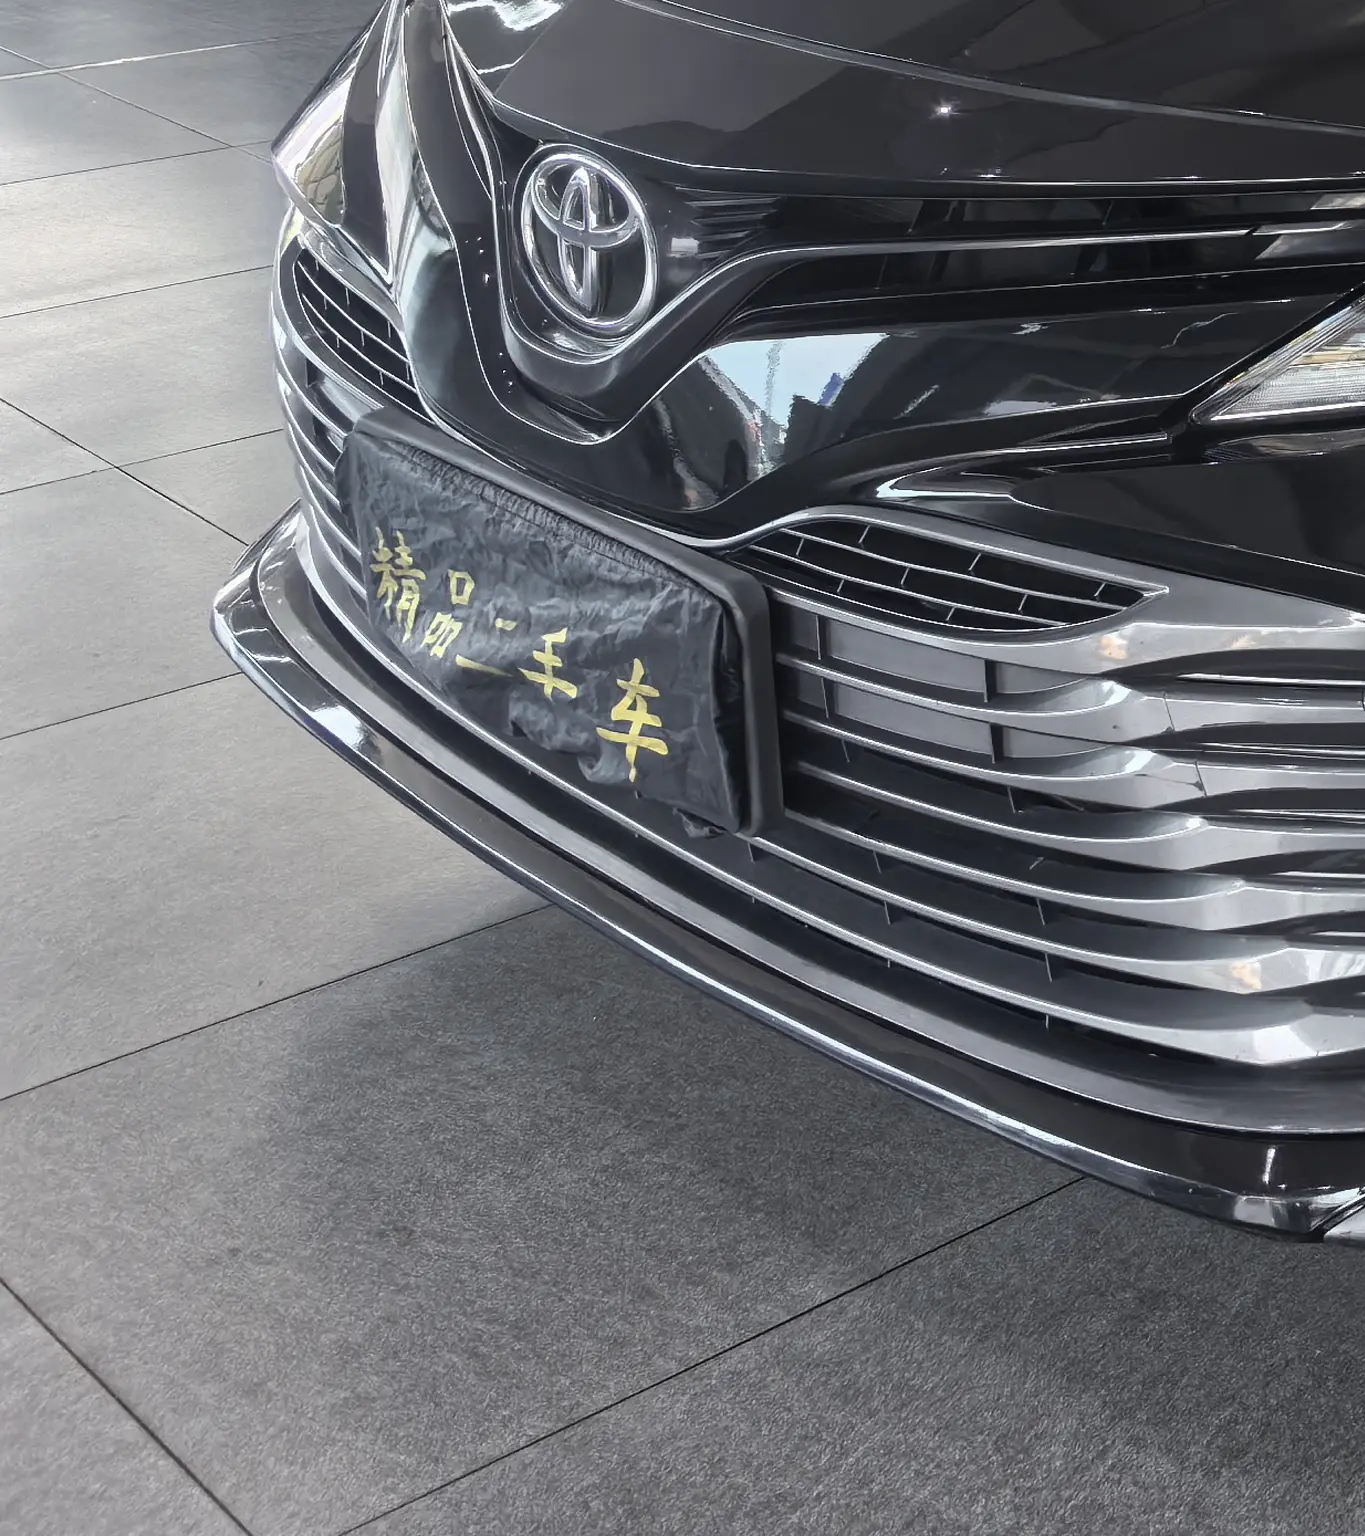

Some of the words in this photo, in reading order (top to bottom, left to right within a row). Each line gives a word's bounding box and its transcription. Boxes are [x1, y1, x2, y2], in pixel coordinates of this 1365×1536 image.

[369, 527, 669, 783] 精品二手车
